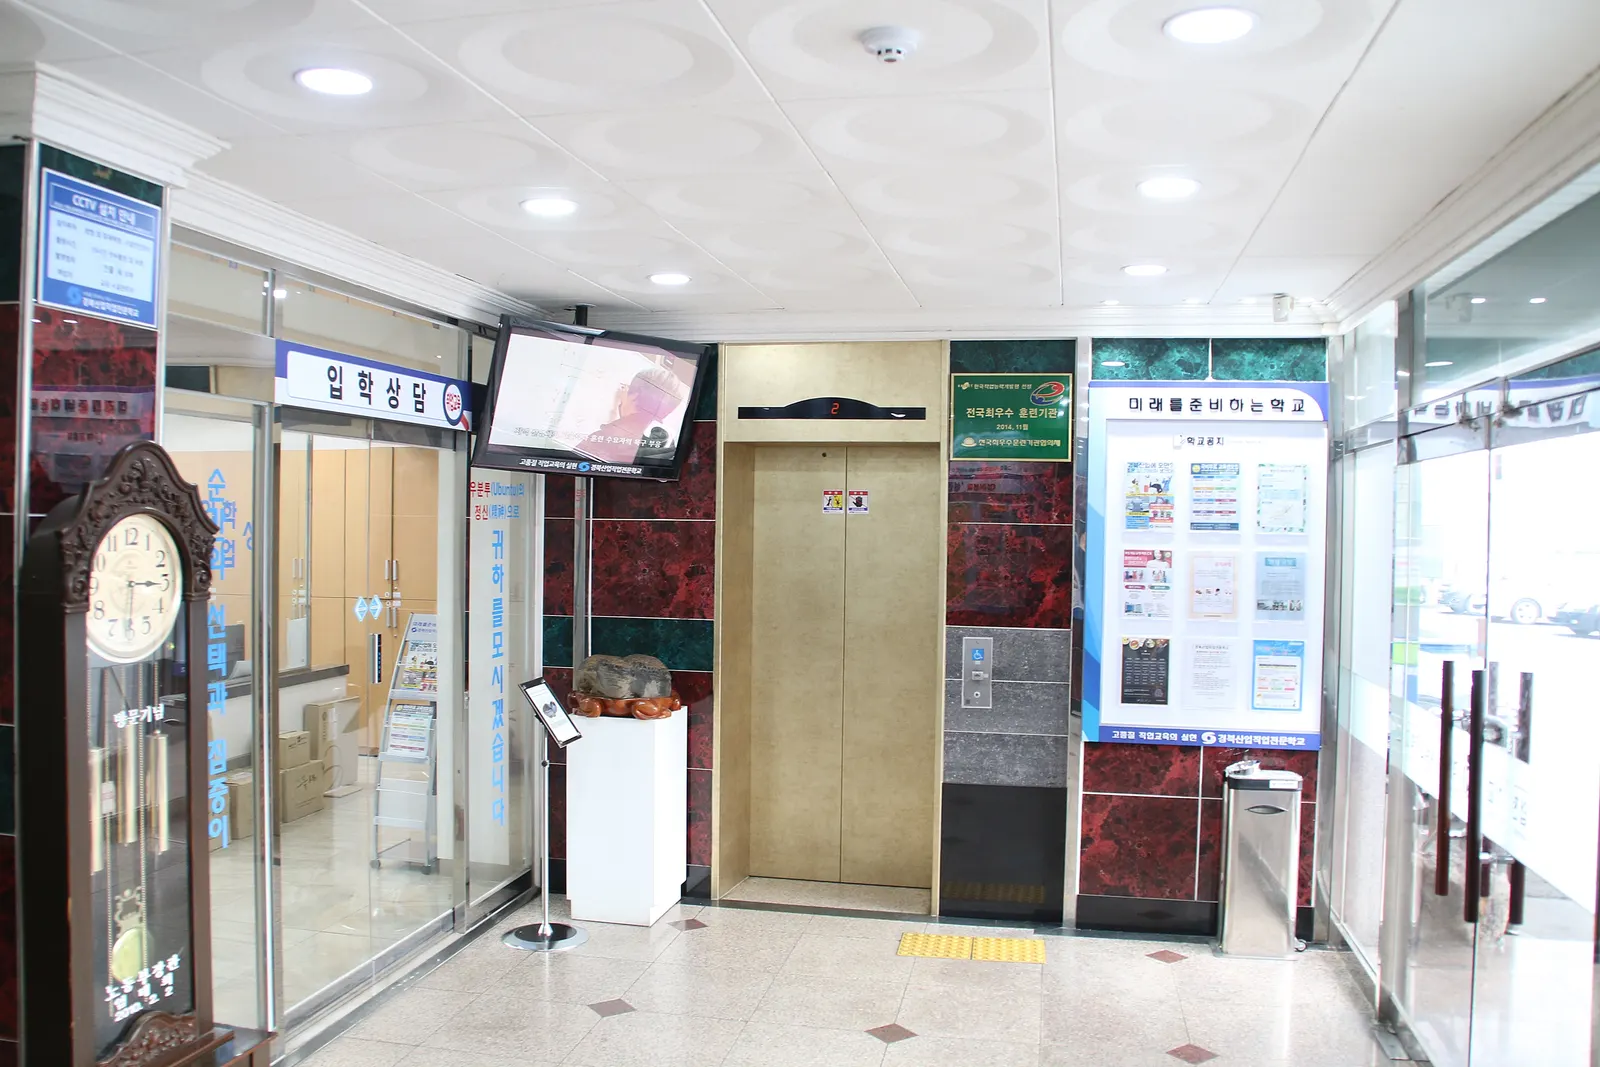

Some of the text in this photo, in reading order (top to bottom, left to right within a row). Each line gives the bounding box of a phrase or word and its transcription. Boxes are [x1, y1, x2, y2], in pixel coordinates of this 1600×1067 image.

[72, 194, 97, 211] CCTV
[831, 402, 840, 415] 2
[966, 407, 1058, 419] 전국최우수 훈련기관
[107, 535, 117, 552] 11
[125, 527, 139, 546] 12
[145, 534, 151, 551] 1
[155, 550, 165, 568] 2
[93, 600, 105, 620] 8
[152, 598, 165, 614] 4
[108, 618, 118, 637] 7
[141, 615, 151, 635] 5
